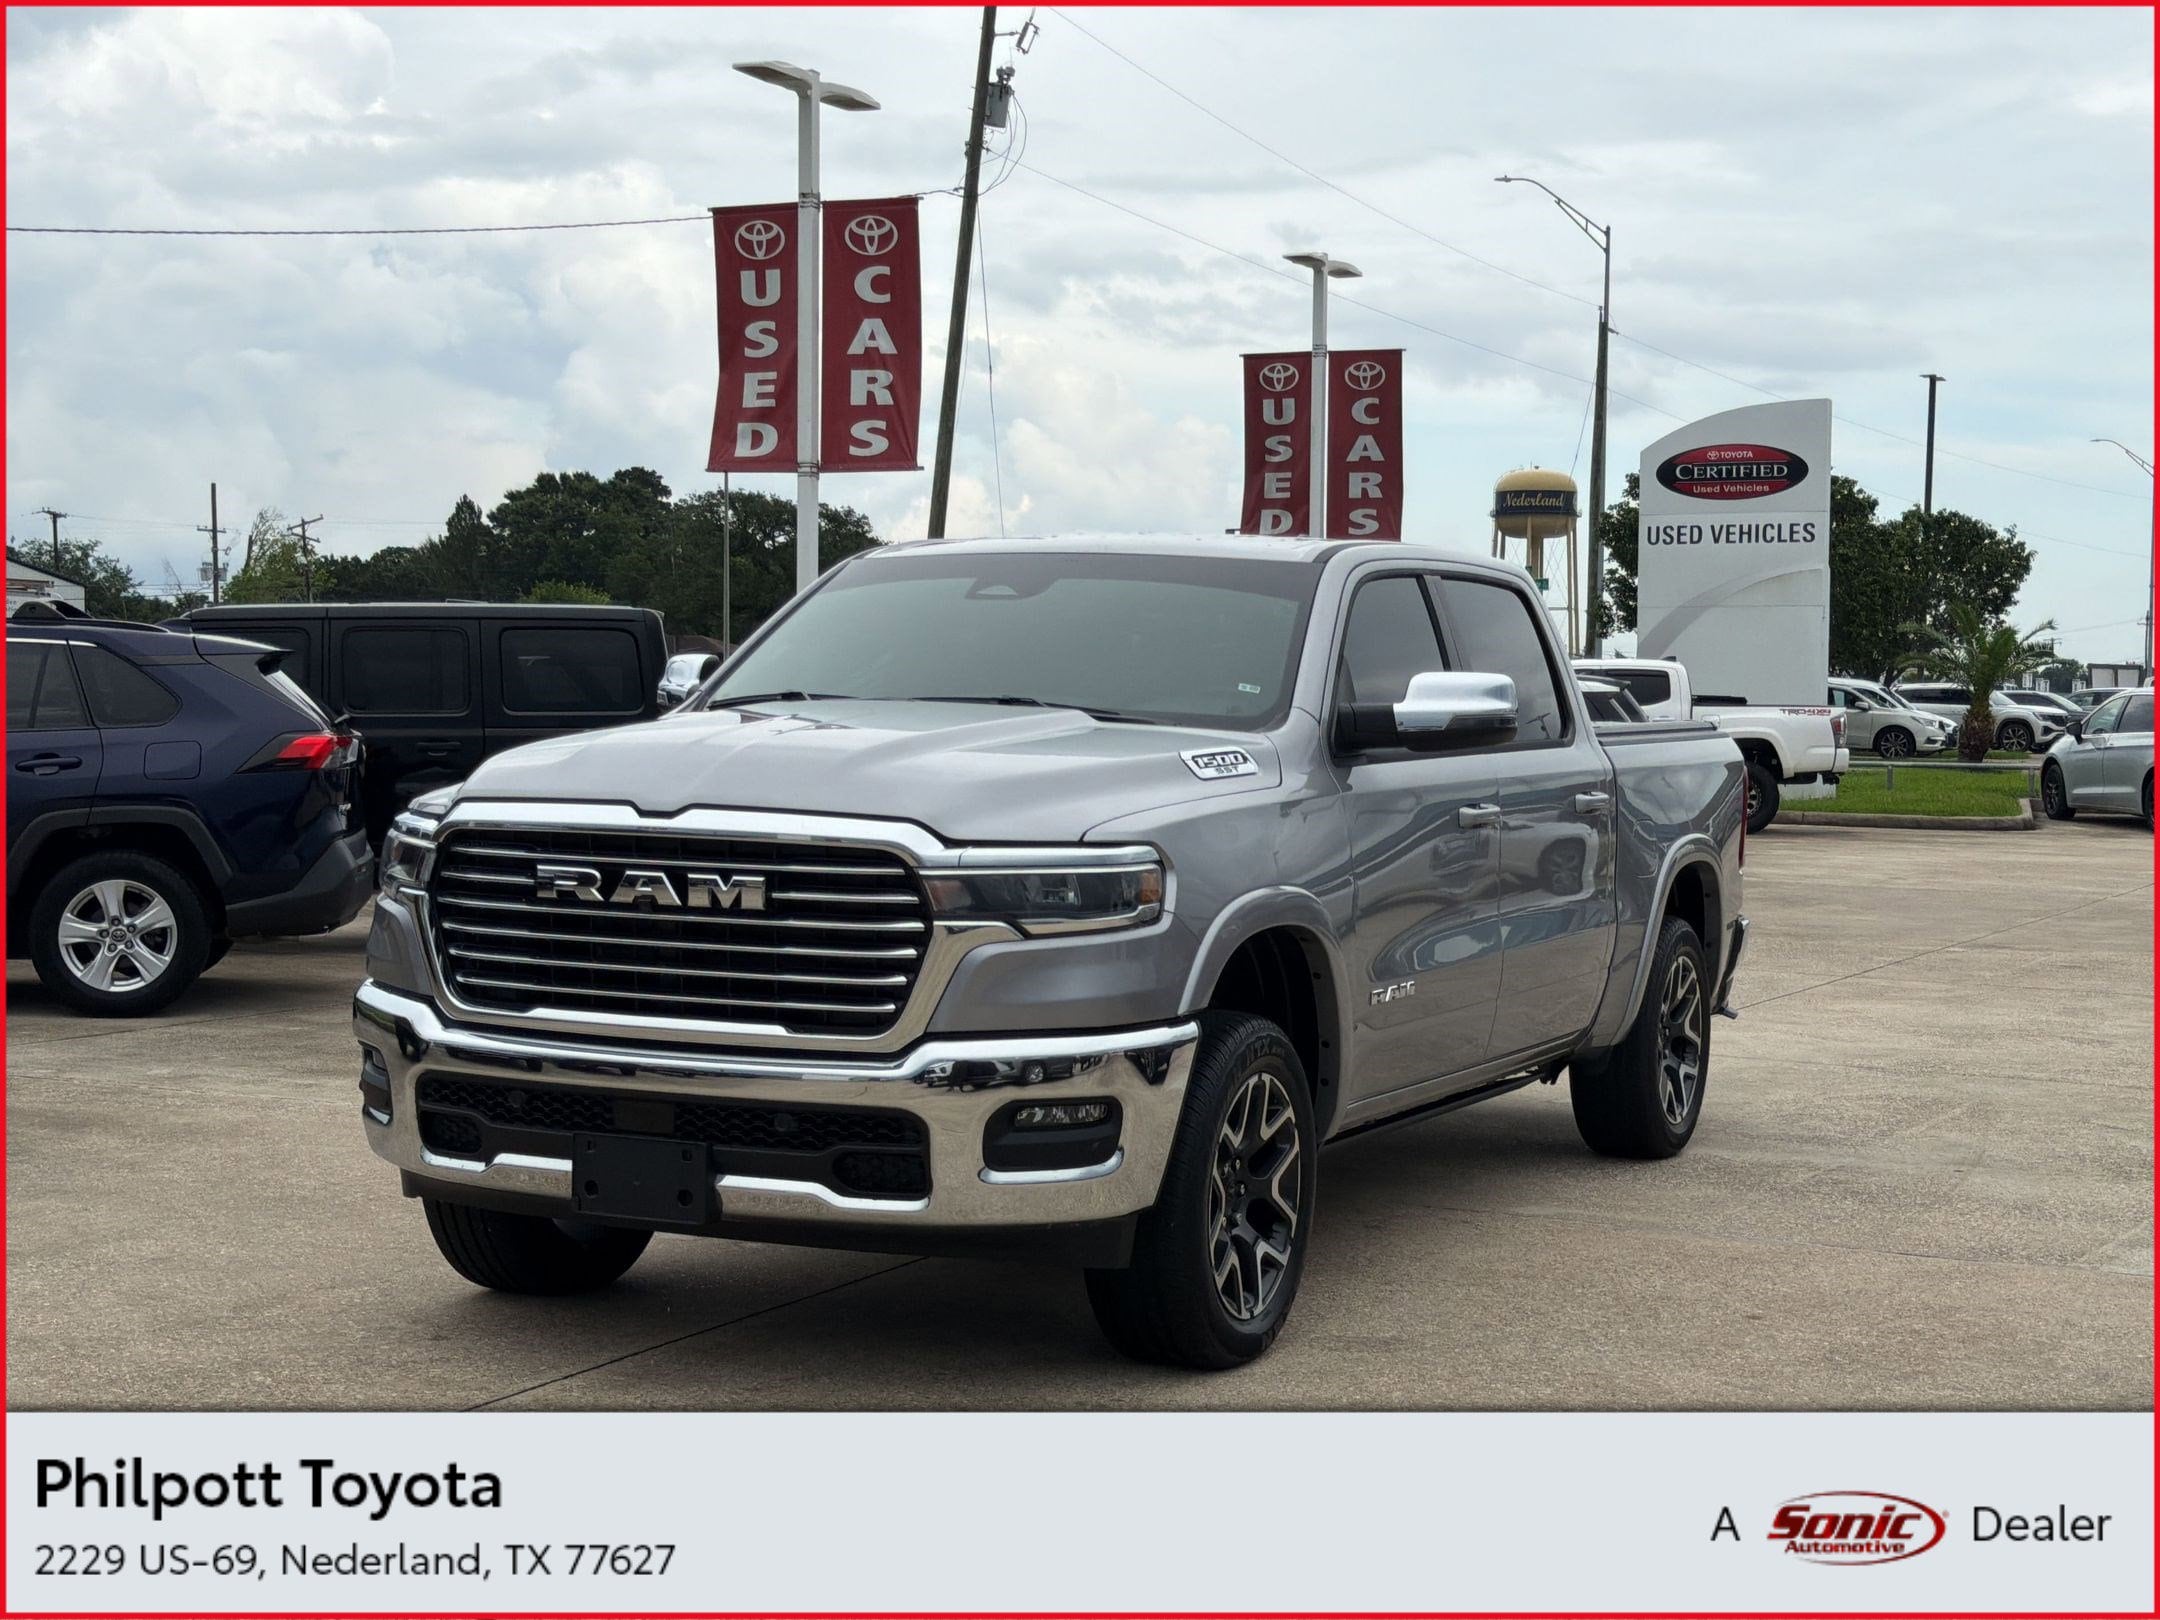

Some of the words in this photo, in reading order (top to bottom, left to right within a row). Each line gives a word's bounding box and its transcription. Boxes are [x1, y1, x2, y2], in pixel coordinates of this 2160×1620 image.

[734, 268, 781, 458] USED
[846, 265, 898, 457] CARS
[1259, 397, 1296, 536] USED
[1346, 397, 1385, 536] CARS
[1720, 450, 1753, 459] TOYOTA
[1503, 492, 1563, 507] Nederland
[1693, 485, 1720, 493] Used
[1724, 483, 1770, 492] Vehicles
[1647, 525, 1703, 546] USED
[1711, 522, 1816, 545] VEHICLES
[1194, 753, 1244, 768] 1500
[536, 864, 766, 910] RAM
